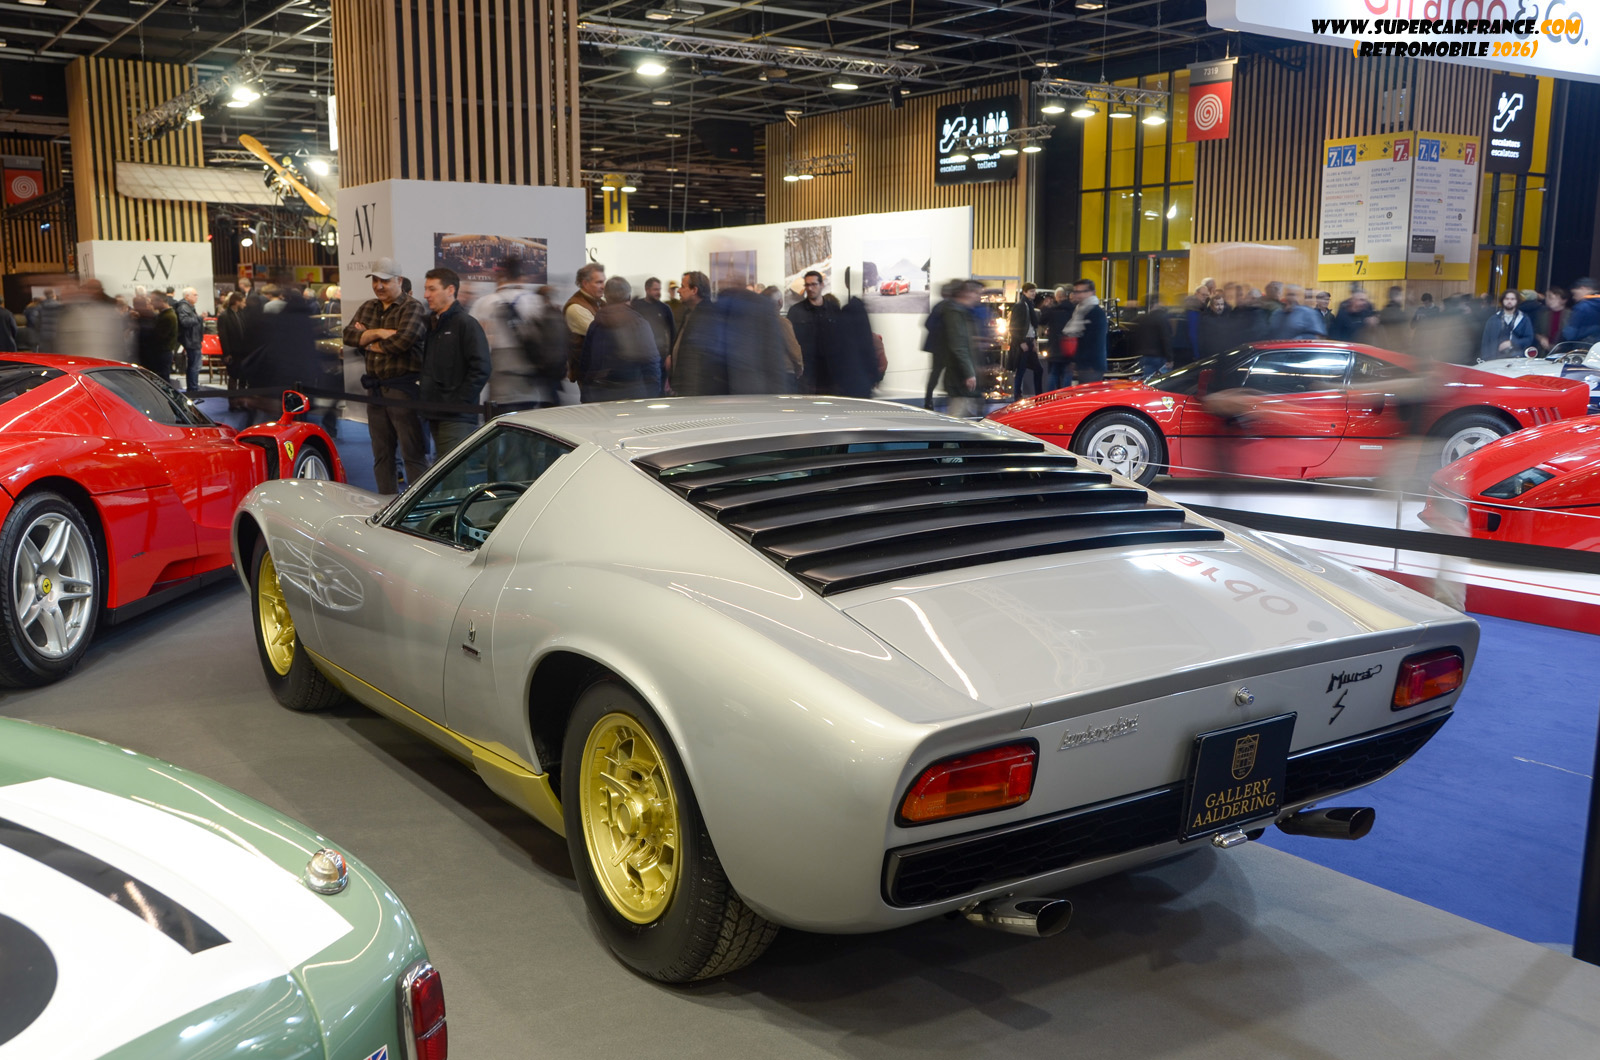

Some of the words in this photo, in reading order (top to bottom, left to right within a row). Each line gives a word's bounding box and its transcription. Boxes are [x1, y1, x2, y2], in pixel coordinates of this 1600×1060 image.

[1203, 66, 1219, 76] 7319
[1345, 149, 1353, 164] 4
[1395, 144, 1408, 161] 7.2
[1430, 145, 1438, 160] 4
[610, 186, 621, 224] H
[132, 254, 177, 281] AW
[1355, 260, 1367, 275] 7.3
[1325, 664, 1382, 693] Miura
[1328, 688, 1348, 725] S
[1205, 778, 1271, 808] GALLERY
[1192, 792, 1276, 828] AALDERING
